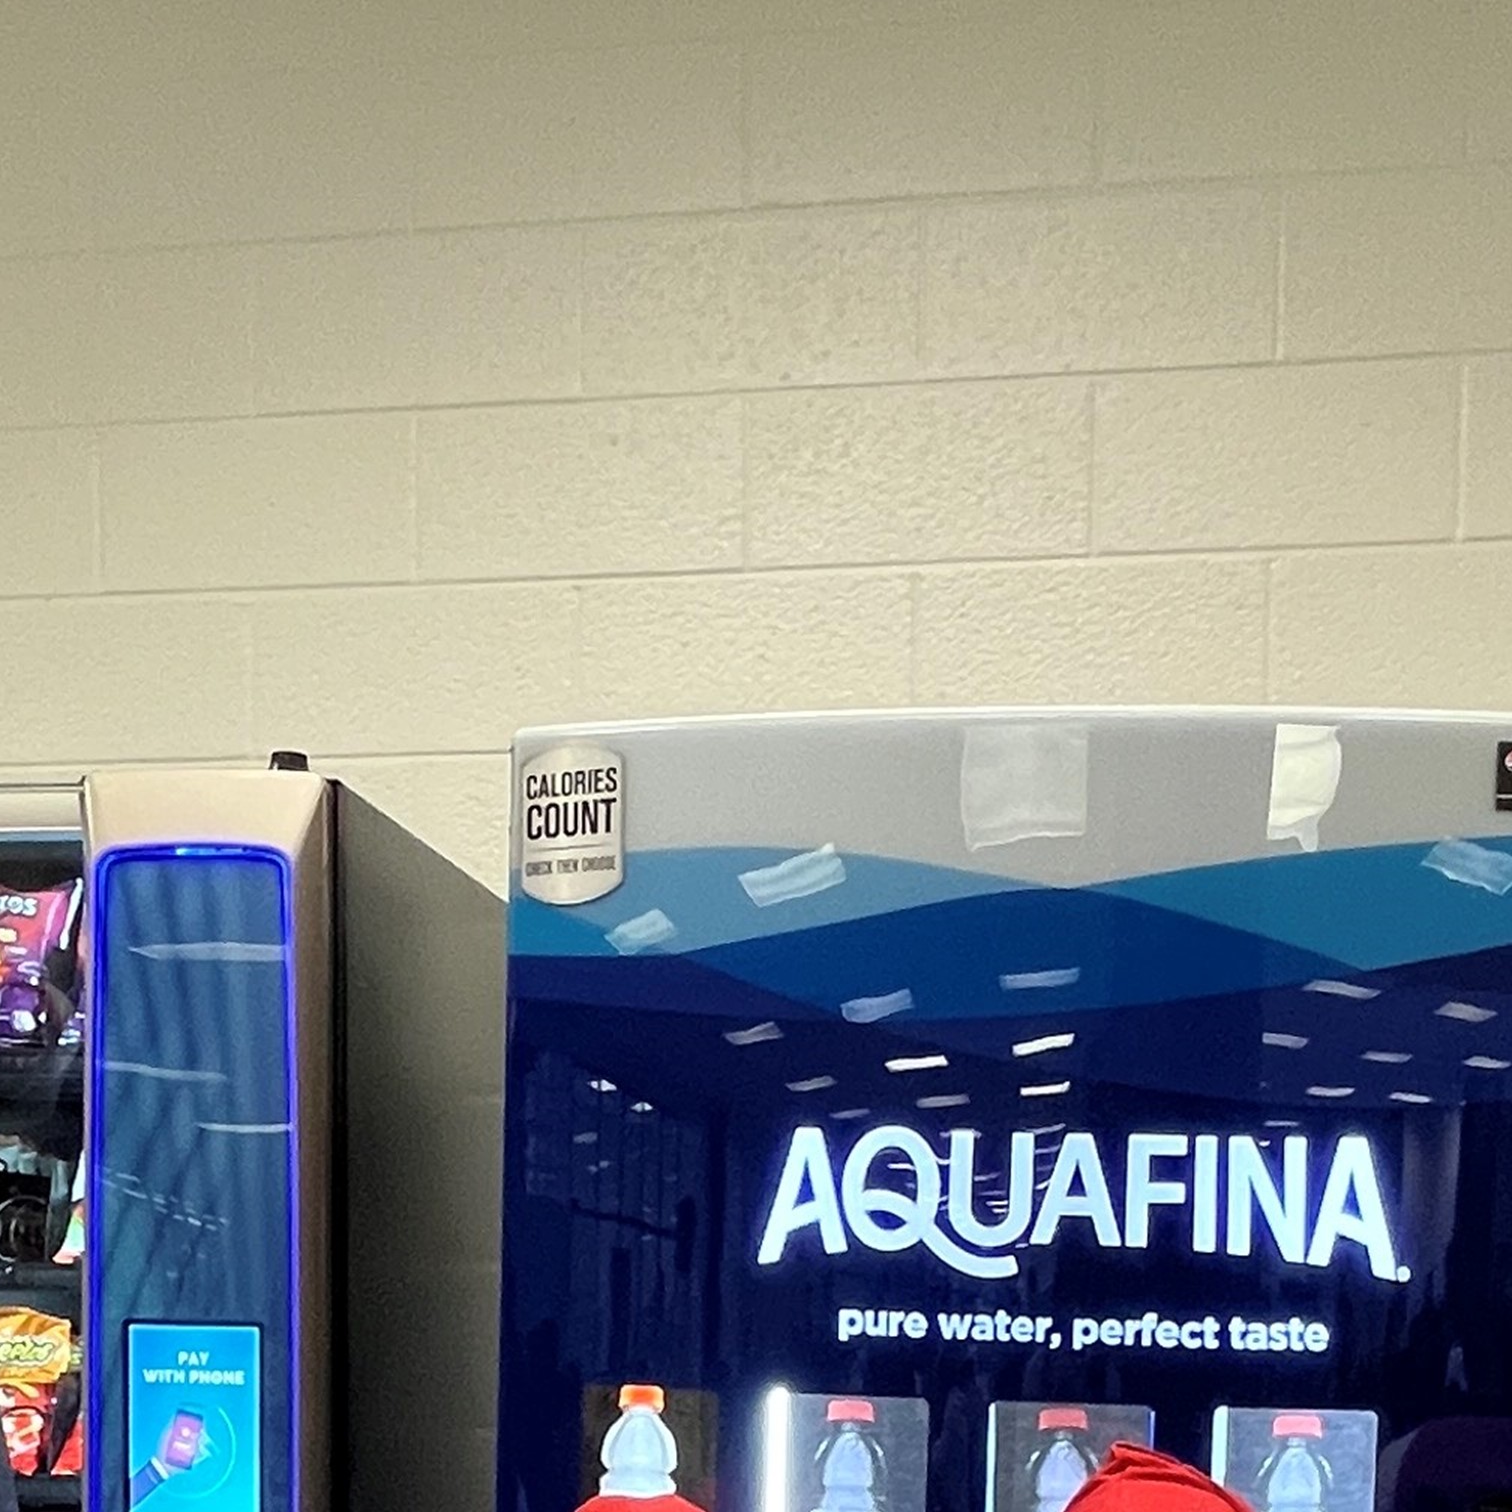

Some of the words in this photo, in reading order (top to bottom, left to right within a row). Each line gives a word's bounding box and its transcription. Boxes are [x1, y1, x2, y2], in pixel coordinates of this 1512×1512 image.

[526, 767, 618, 800] CALORIES
[527, 798, 617, 840] COUNT
[757, 1124, 1398, 1282] AQUAFINA
[838, 1307, 929, 1341] pure
[938, 1309, 1062, 1348] water,
[1072, 1311, 1220, 1350] perfect
[1228, 1316, 1331, 1352] taste
[177, 1350, 210, 1366] PAY
[142, 1368, 186, 1384] WITH
[188, 1370, 245, 1386] PHONE
